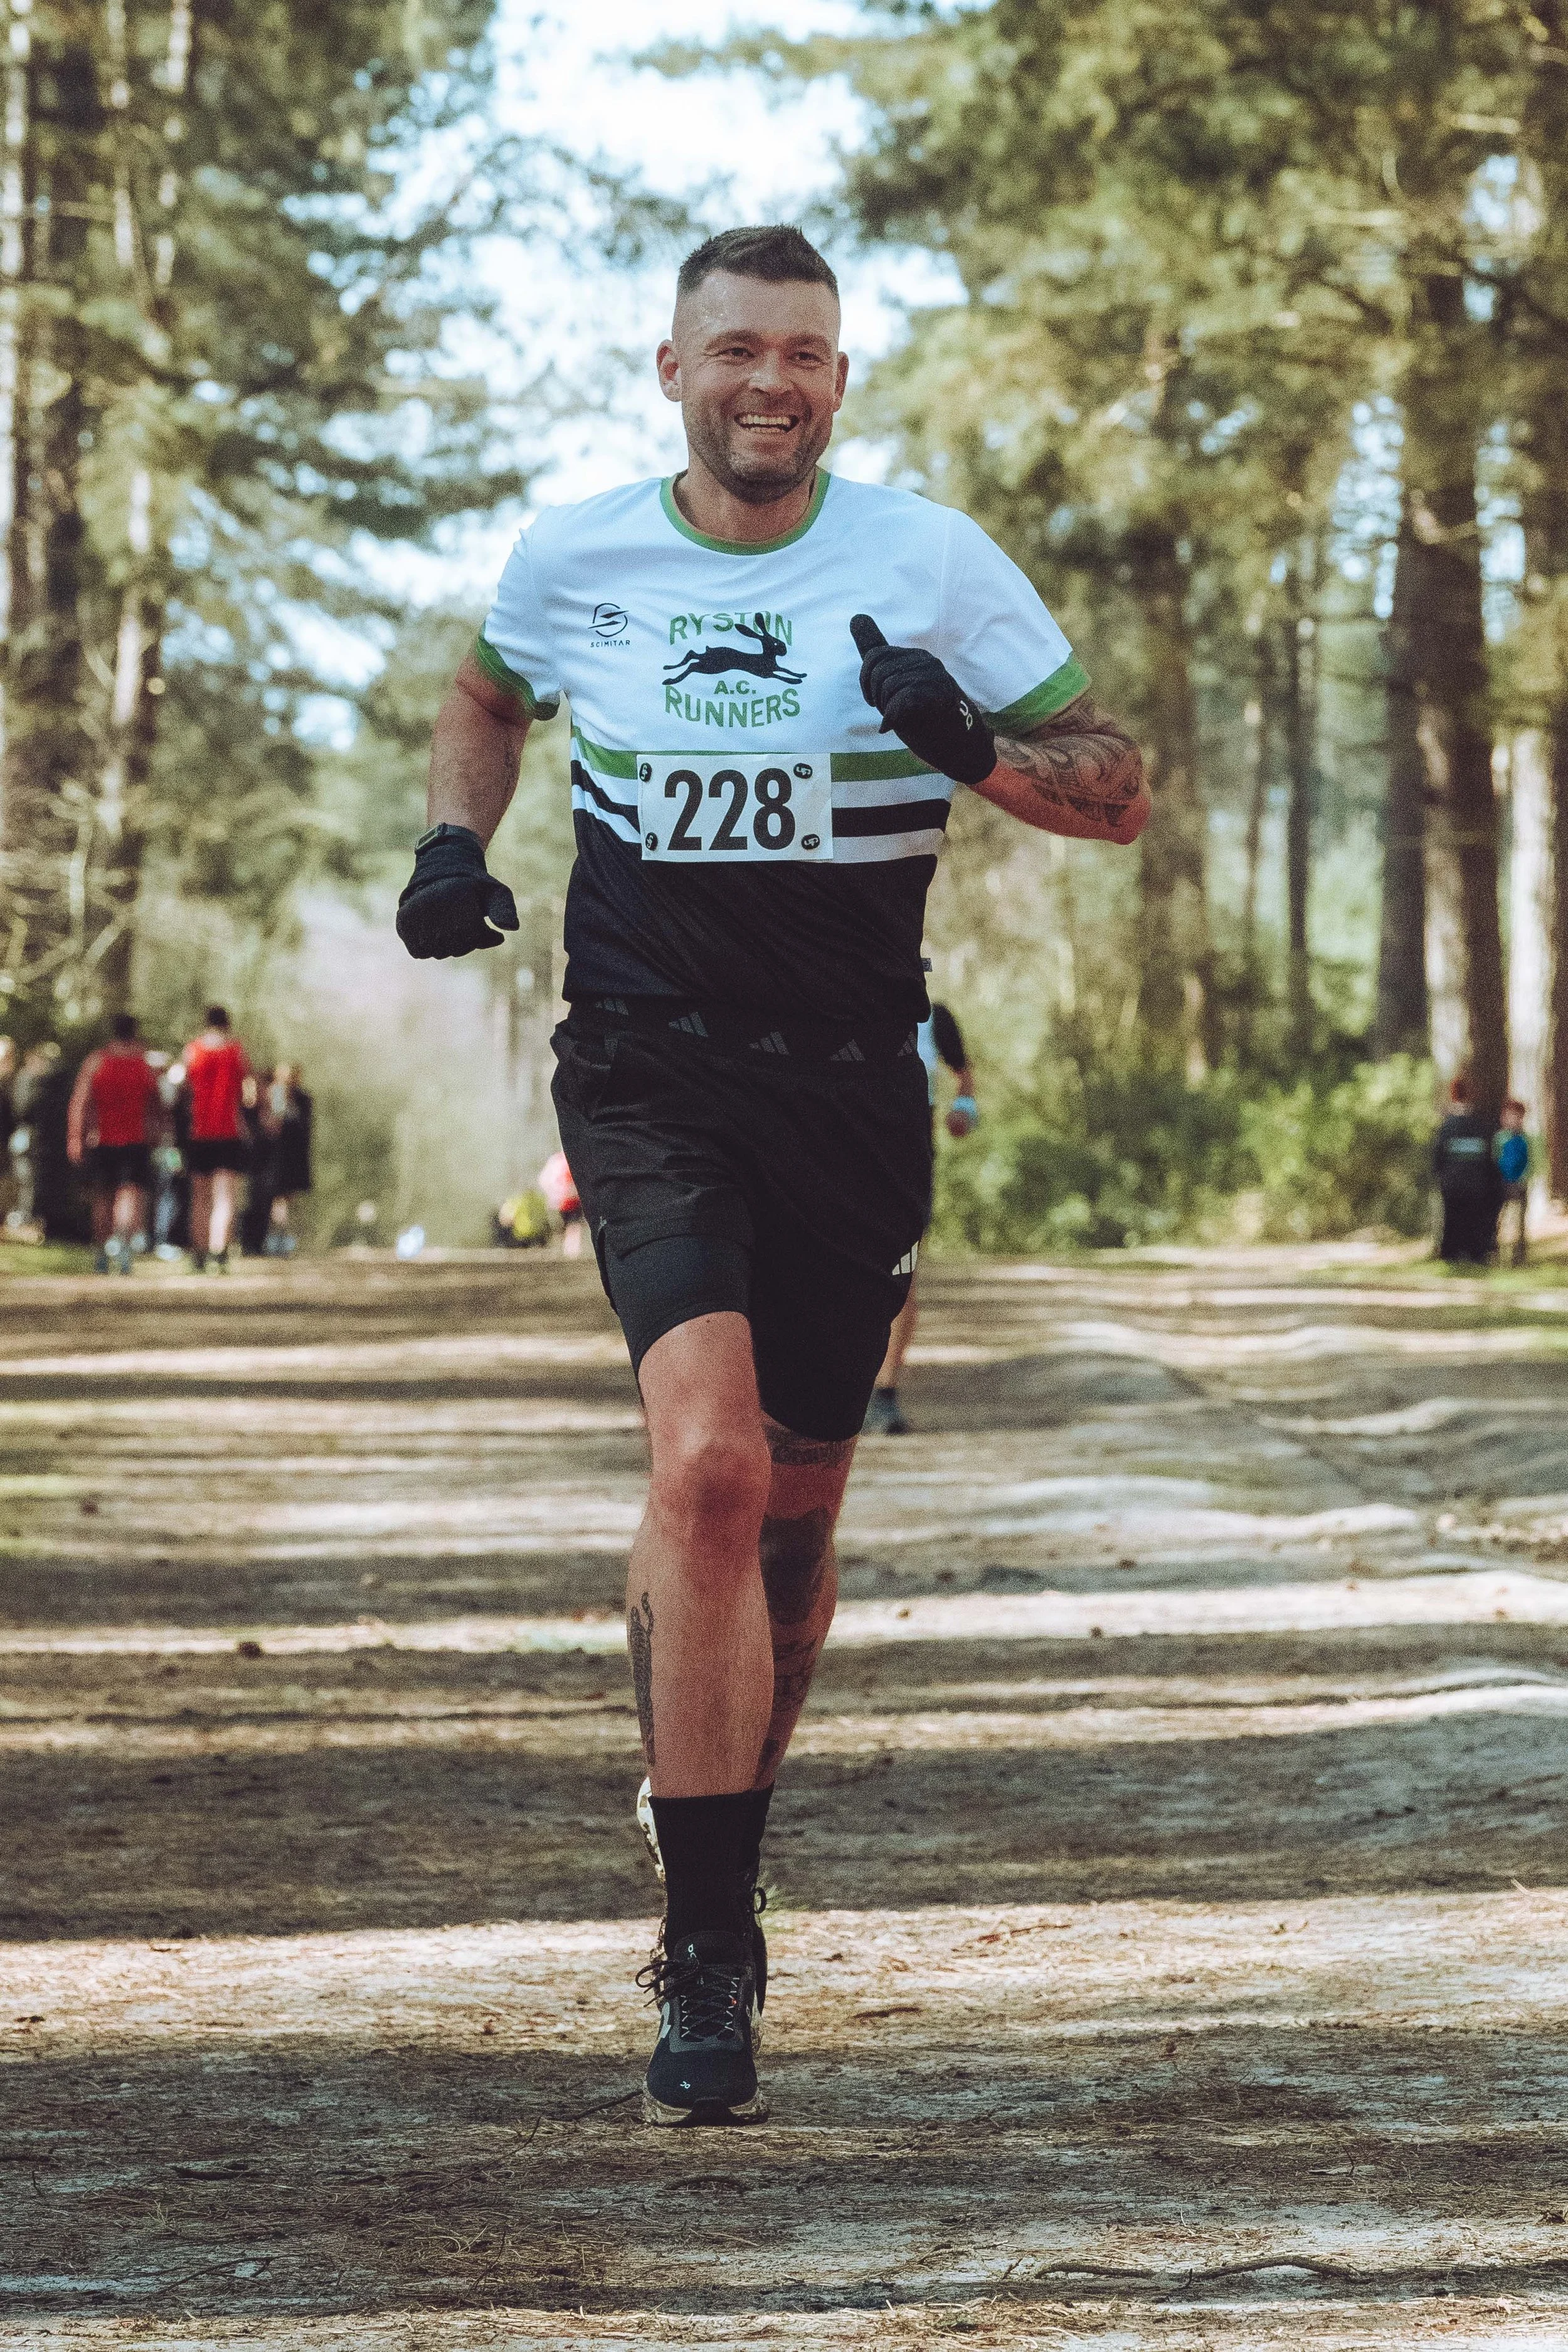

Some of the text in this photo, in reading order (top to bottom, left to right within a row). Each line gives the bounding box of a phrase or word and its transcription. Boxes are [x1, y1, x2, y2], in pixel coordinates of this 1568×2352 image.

[664, 686, 800, 728] RUNNERS
[714, 681, 756, 694] A.C.
[664, 768, 795, 850] 228
